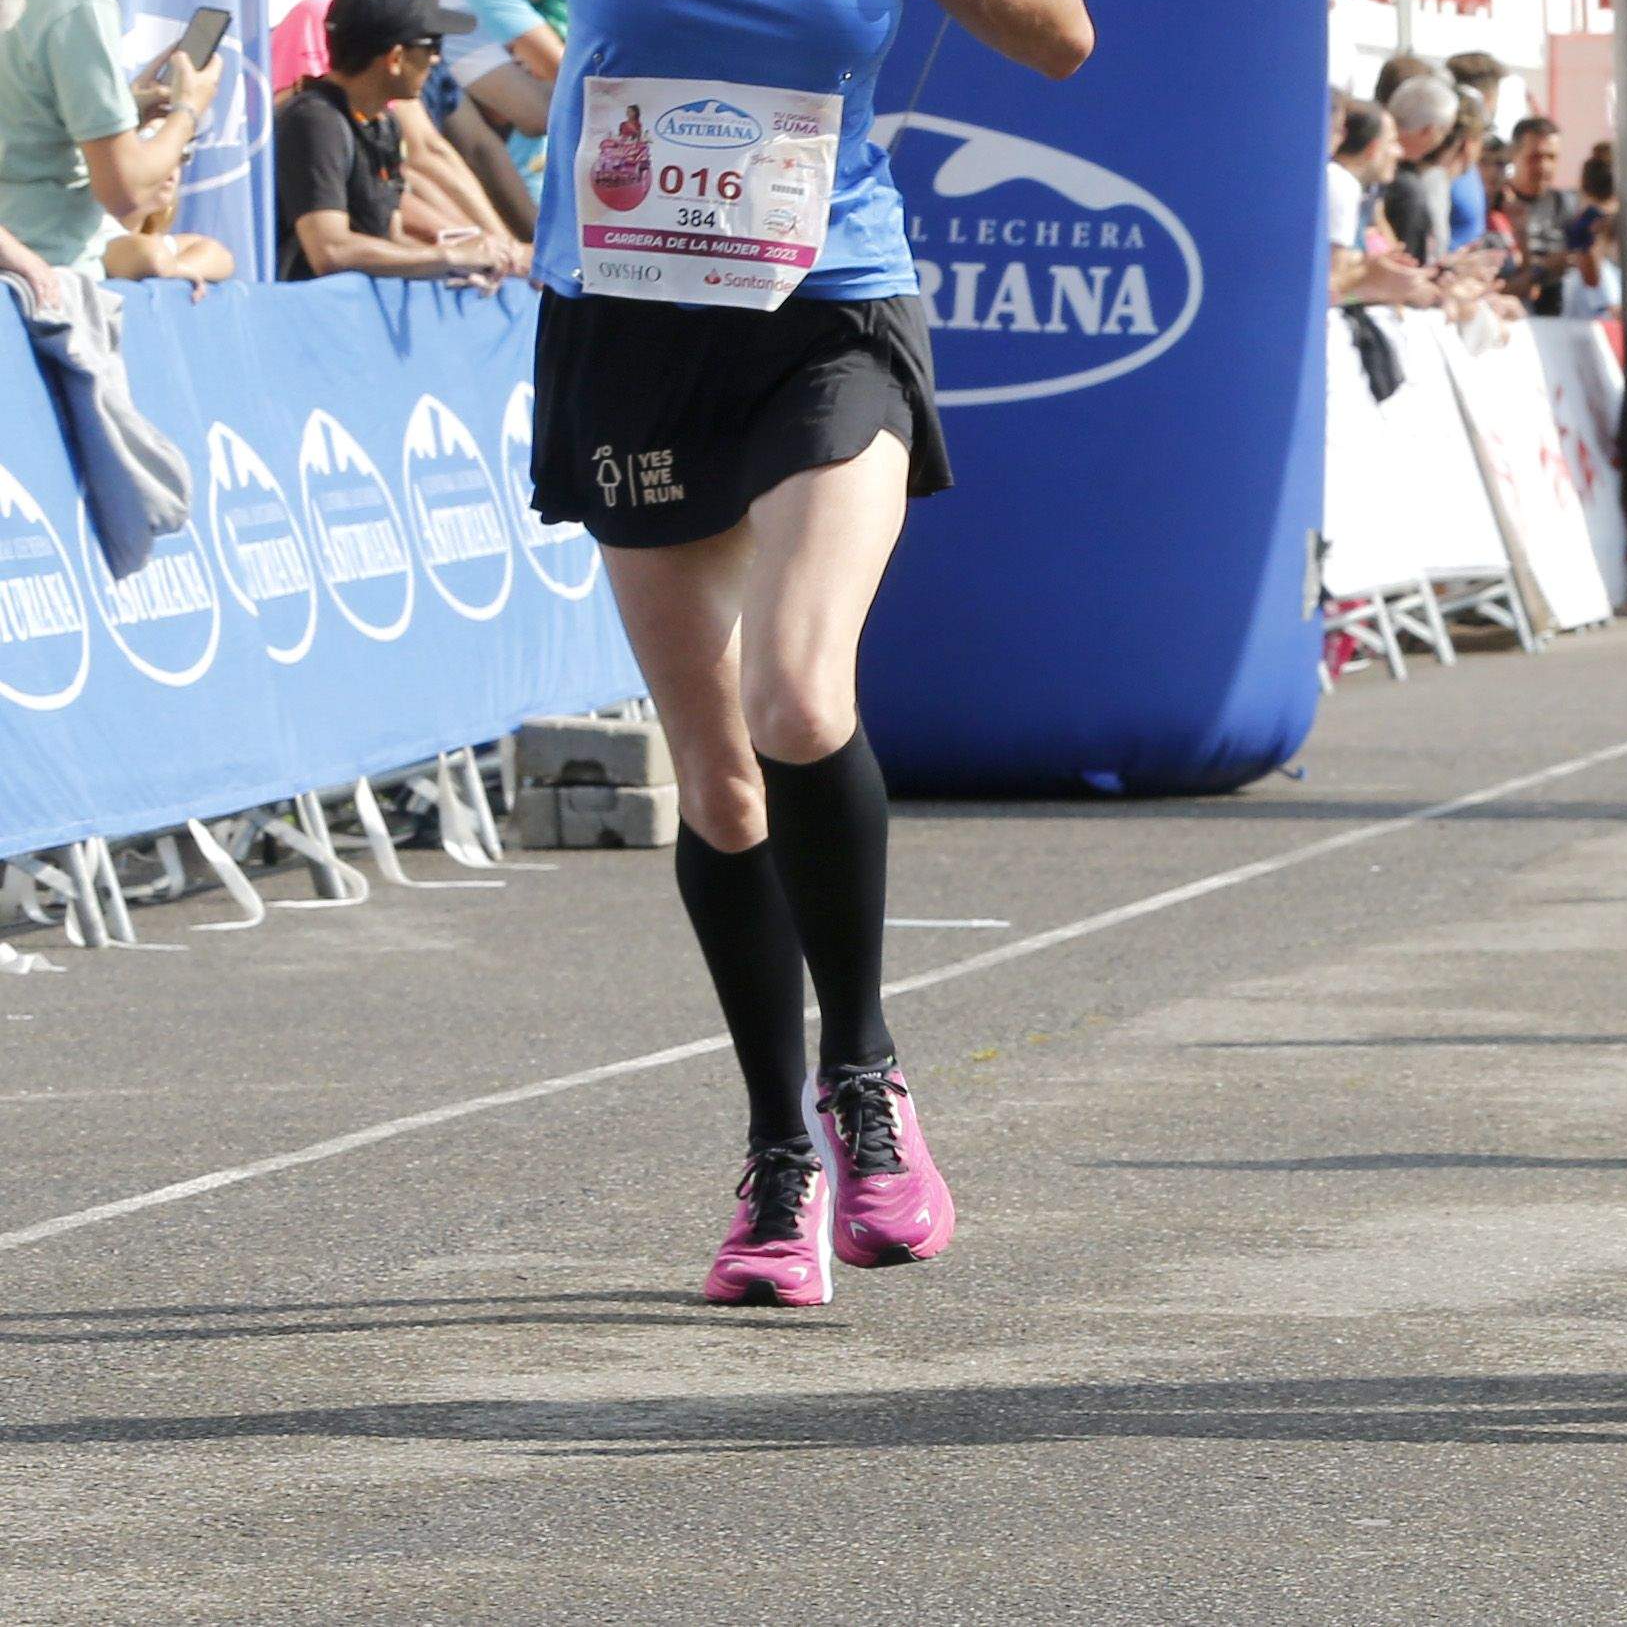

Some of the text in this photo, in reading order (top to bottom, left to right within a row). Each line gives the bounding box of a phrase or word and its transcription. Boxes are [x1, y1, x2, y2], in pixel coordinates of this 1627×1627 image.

[660, 120, 755, 142] ASTURIANA
[772, 119, 820, 137] SUMA
[659, 164, 743, 201] 016
[949, 218, 1146, 250] LECHERA
[603, 231, 798, 262] CARRERA DE LA MUJER 2023
[598, 261, 661, 283] OYSHO
[638, 448, 674, 469] YES
[640, 468, 673, 487] WE
[643, 484, 685, 505] RUN
